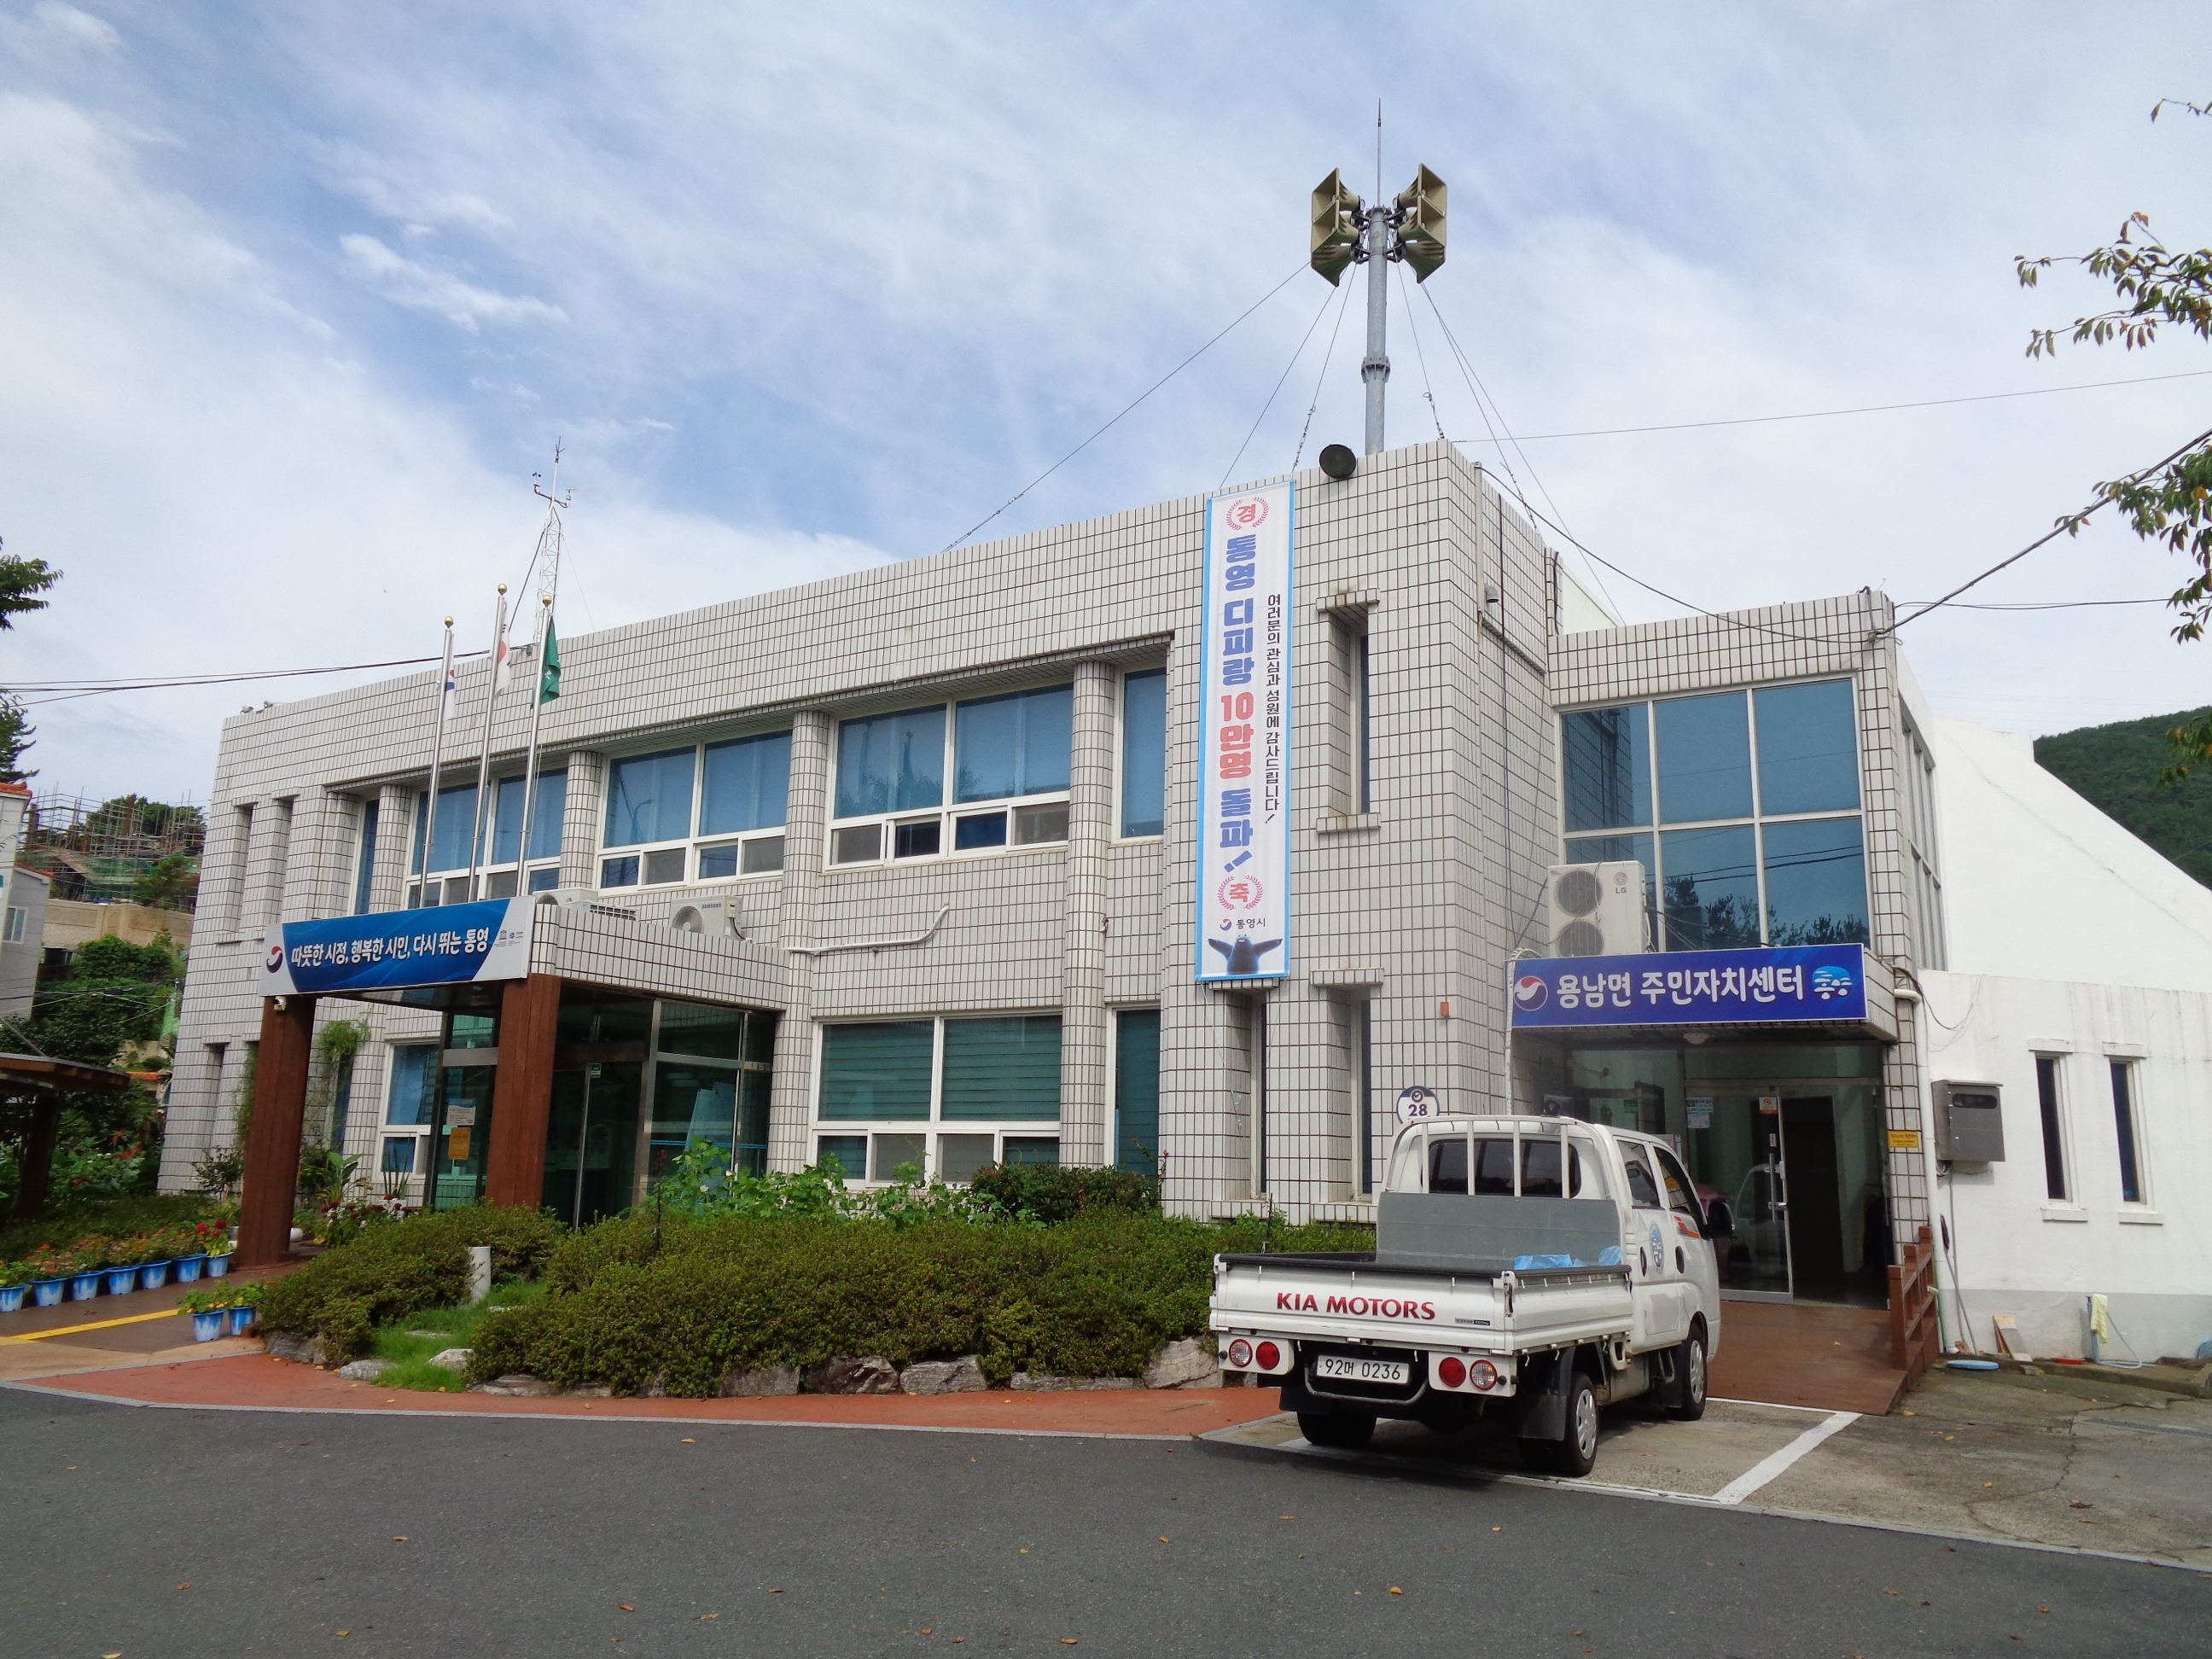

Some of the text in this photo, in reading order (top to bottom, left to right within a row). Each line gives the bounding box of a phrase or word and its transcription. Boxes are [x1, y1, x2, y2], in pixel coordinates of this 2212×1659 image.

[1236, 504, 1257, 523] 경
[1225, 533, 1257, 591] 통영
[1222, 597, 1255, 686] 디피랑
[1266, 647, 1281, 687] 관심과
[1266, 690, 1280, 728] 성원에
[1220, 691, 1254, 780] 10만명
[1229, 882, 1249, 903] 축
[1236, 917, 1266, 930] 통영시
[291, 943, 324, 968] 따뜻한
[324, 940, 349, 965] 시정,
[351, 937, 384, 963] 행복한
[385, 934, 411, 959] 시민,
[413, 932, 438, 957] 다시
[439, 930, 463, 955] 뛰는
[464, 927, 490, 953] 통영
[1556, 973, 1632, 1010] 용남면
[1639, 964, 1804, 1006] 주민자치센터
[1407, 1103, 1428, 1116] 28
[1277, 1292, 1436, 1320] KIA MOTORS
[1325, 1359, 1400, 1380] 92머 0236
